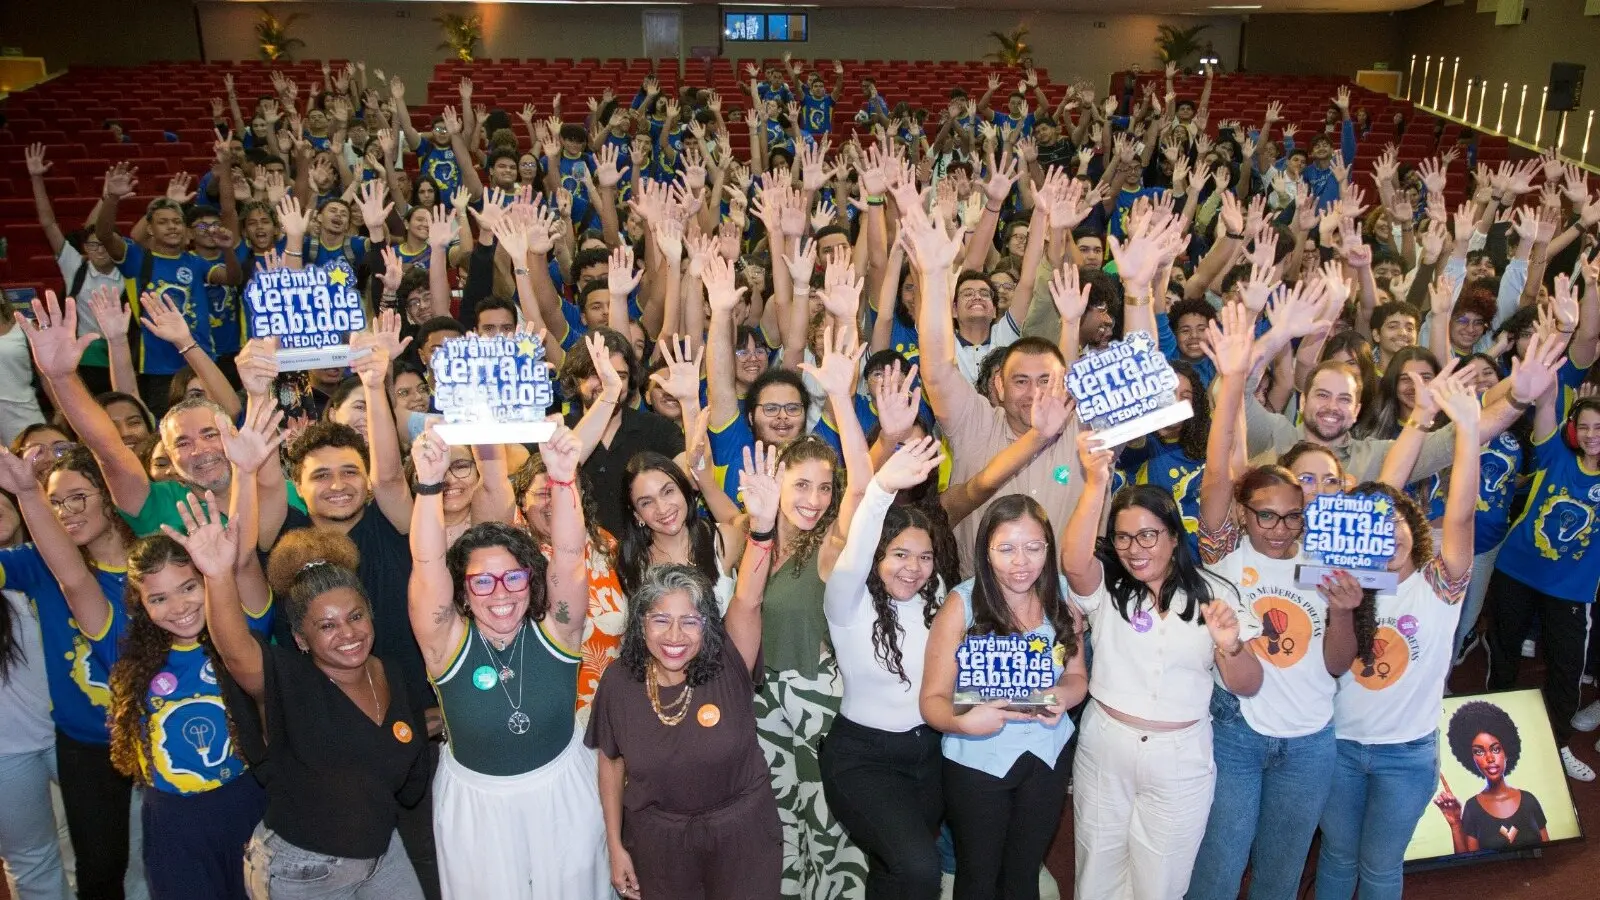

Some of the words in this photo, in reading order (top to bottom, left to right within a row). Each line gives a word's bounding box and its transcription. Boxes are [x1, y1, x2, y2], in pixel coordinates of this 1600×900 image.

[259, 266, 328, 292] prêmio
[249, 283, 333, 314] terra
[335, 288, 359, 308] de
[254, 301, 364, 337] sabidos
[446, 336, 516, 359] prêmio
[1073, 343, 1133, 378] prêmio
[436, 351, 519, 385] terra
[520, 358, 546, 382] de
[1068, 356, 1140, 400] terra
[1140, 351, 1166, 375] de
[1079, 370, 1175, 422] sabidos
[1318, 494, 1374, 513] prêmio
[1306, 504, 1374, 536] terra
[1373, 515, 1395, 537] de
[1305, 527, 1396, 556] sabidos
[957, 646, 1028, 671] terra
[1029, 653, 1052, 671] de
[969, 636, 1028, 653] prêmio
[959, 664, 1054, 688] sabidos
